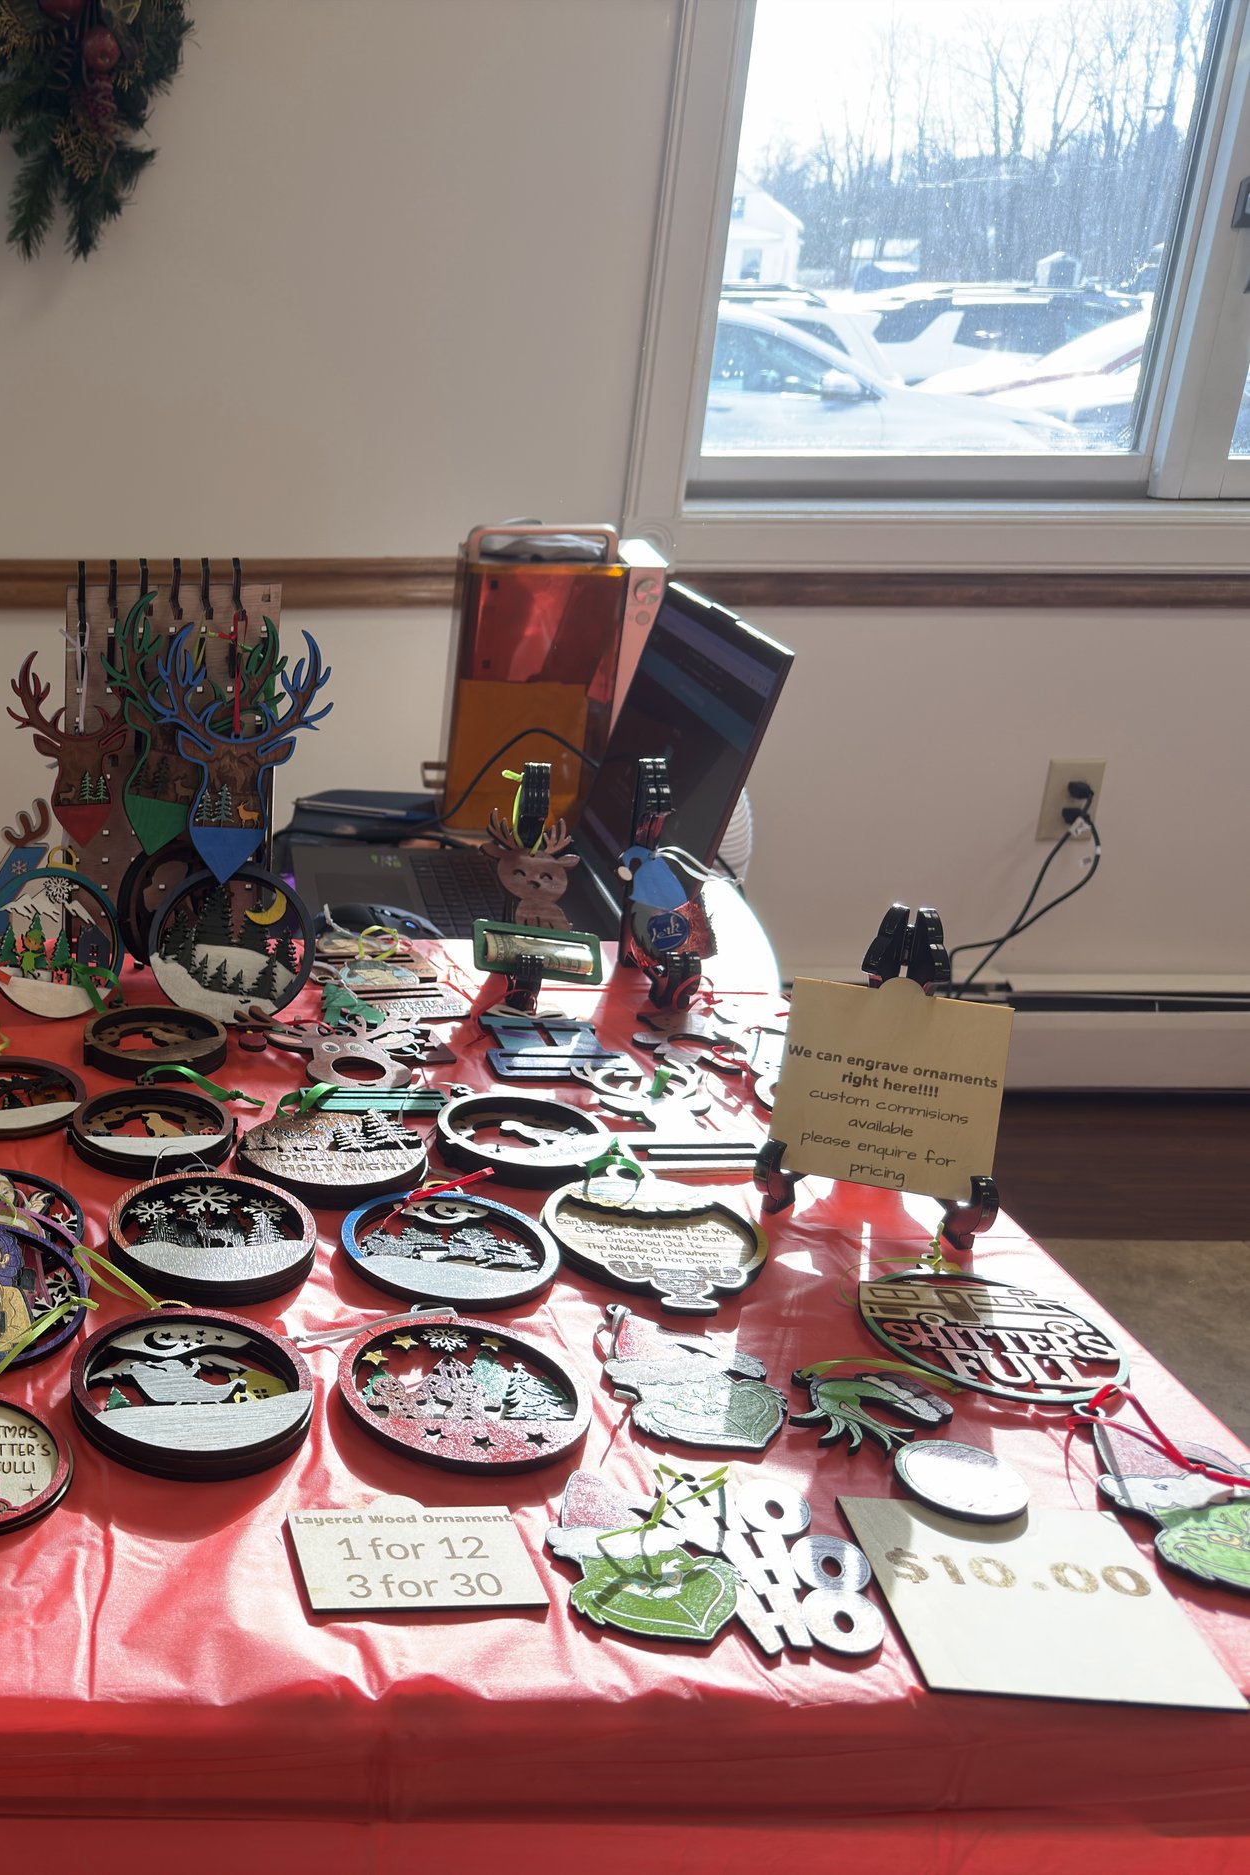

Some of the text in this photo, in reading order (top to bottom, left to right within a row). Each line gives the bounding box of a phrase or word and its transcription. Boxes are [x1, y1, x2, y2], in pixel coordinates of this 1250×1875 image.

[788, 1043, 999, 1089] We can engrave ornaments
[841, 1072, 939, 1098] right here!!!!
[809, 1089, 969, 1125] custom commisions
[848, 1117, 914, 1138] available
[800, 1131, 956, 1168] please enquire for
[281, 1162, 408, 1172] HOLY NIGHT
[850, 1162, 906, 1188] pricing
[585, 1242, 608, 1251] The
[610, 1244, 649, 1254] Middle
[668, 1248, 720, 1258] Nowhere
[605, 1236, 636, 1246] Drive
[638, 1238, 661, 1247] You
[664, 1239, 686, 1248] Out
[600, 1251, 636, 1261] Leave
[638, 1254, 661, 1263] You
[664, 1255, 683, 1264] For
[881, 1321, 1120, 1361] SHITTERS
[936, 1347, 1098, 1389] FULL
[294, 1514, 365, 1527] Layered
[368, 1514, 418, 1524] Wood
[336, 1535, 490, 1562] 1 for 12
[346, 1572, 504, 1599] 3 for 30
[885, 1547, 1152, 1598] $10.00
